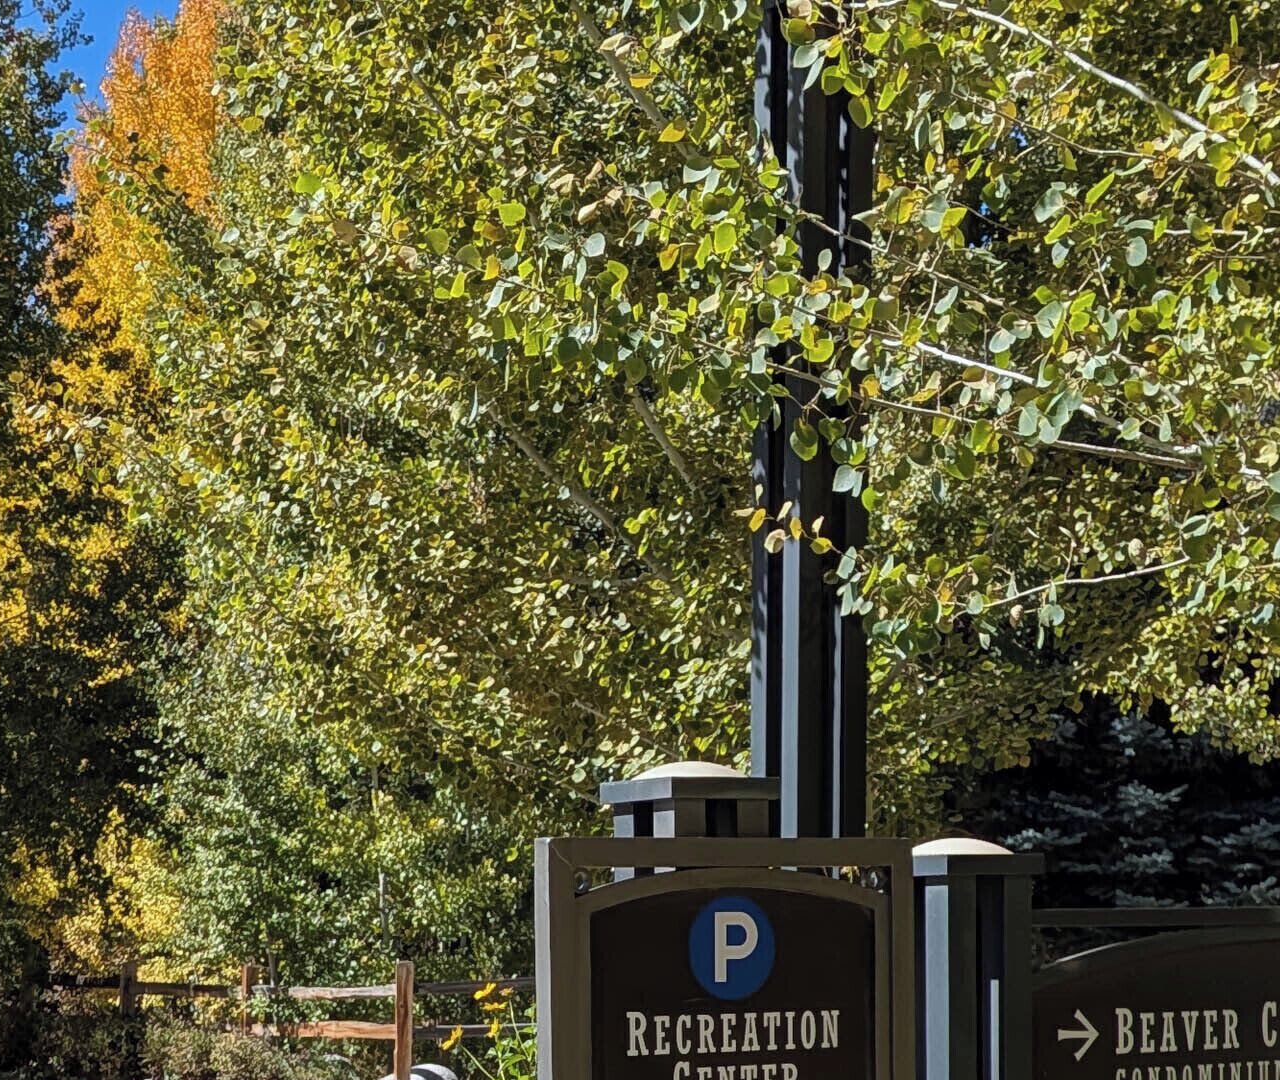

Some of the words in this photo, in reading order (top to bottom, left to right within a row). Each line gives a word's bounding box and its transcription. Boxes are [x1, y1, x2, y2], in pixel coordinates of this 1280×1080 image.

[714, 911, 759, 983] P
[626, 1009, 840, 1057] RECREATION
[1115, 1007, 1240, 1055] BEAVER
